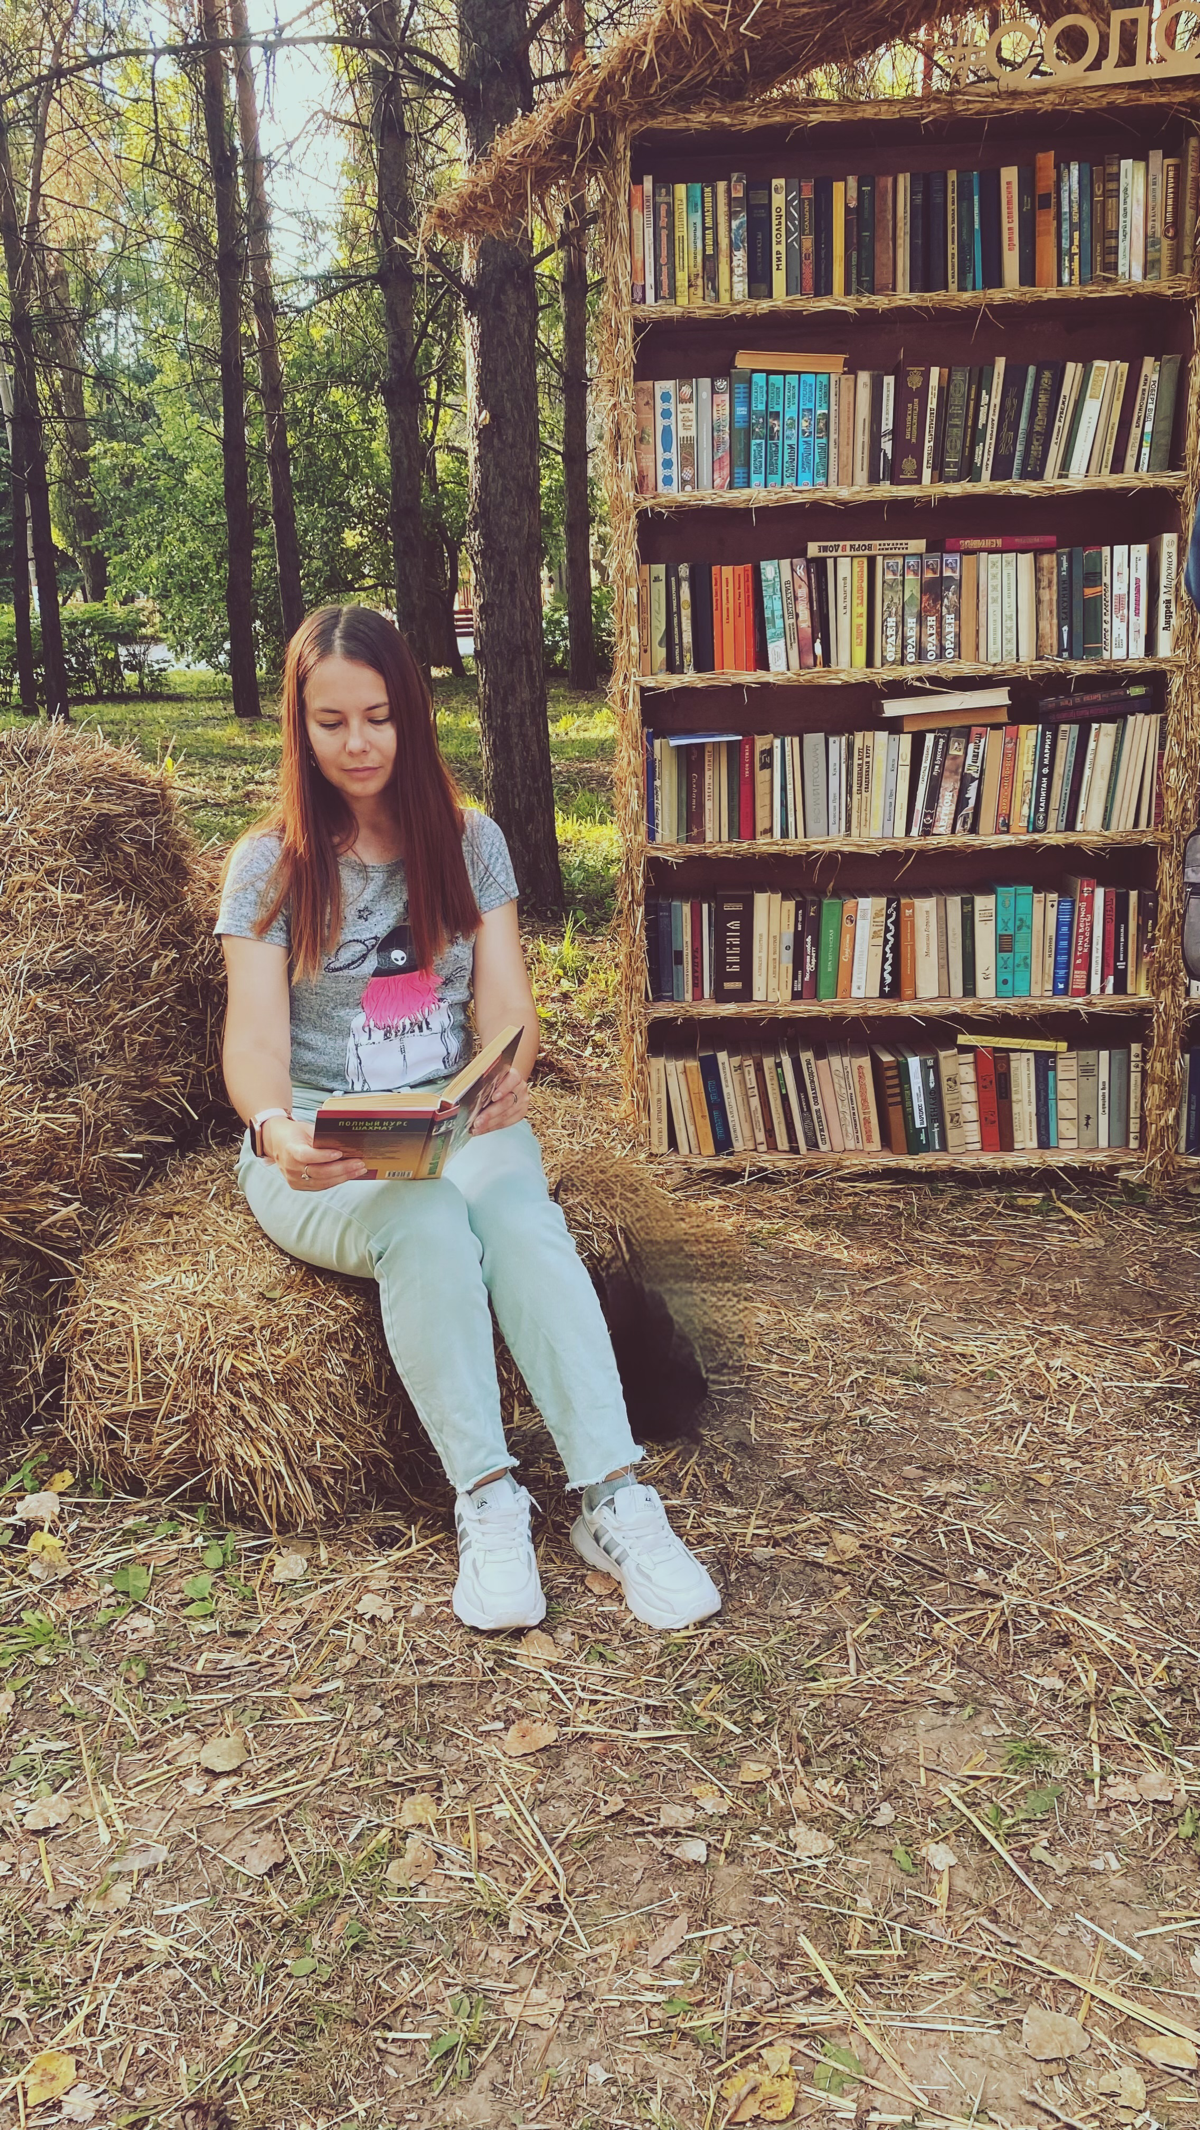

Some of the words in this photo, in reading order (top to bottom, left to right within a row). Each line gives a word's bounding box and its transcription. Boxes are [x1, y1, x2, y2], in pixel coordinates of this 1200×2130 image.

[704, 187, 713, 227] АМАЗОНОК
[705, 229, 714, 254] ВОЙНА
[775, 206, 783, 245] КОЛЬЦО
[1058, 395, 1067, 423] РУБЕЖИ
[817, 544, 840, 553] ДОМЕ
[849, 543, 873, 552] ВОРЫ
[1163, 551, 1174, 596] Миронов
[784, 580, 794, 620] ДЕТЕКТИВ
[1162, 599, 1173, 631] Андрей
[1043, 731, 1052, 764] МАРРИЭТ
[1041, 766, 1049, 774] Ф.
[1039, 777, 1048, 812] КАПИТАН
[928, 1089, 938, 1123] ФРУНЗЕ
